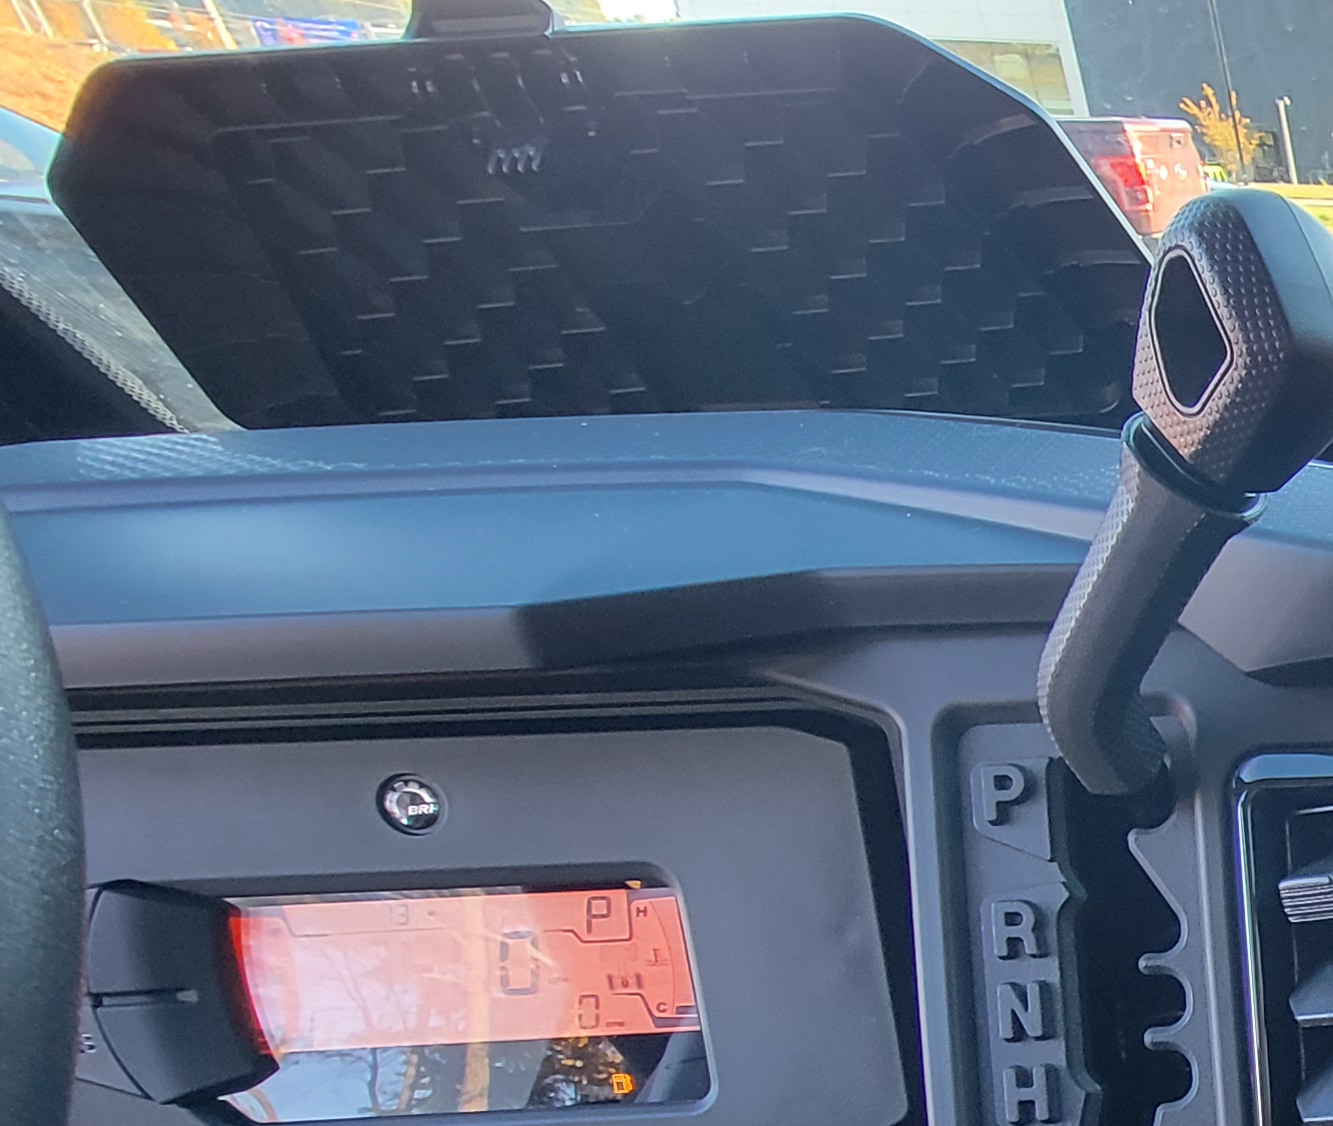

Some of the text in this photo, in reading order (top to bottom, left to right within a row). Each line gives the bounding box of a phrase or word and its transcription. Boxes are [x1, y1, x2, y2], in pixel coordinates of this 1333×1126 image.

[981, 764, 1026, 826] P
[586, 896, 611, 935] P
[635, 906, 647, 917] H
[992, 900, 1040, 958] R
[500, 930, 540, 995] 0
[656, 1001, 668, 1013] C
[998, 983, 1044, 1041] N
[1003, 1064, 1050, 1123] H
